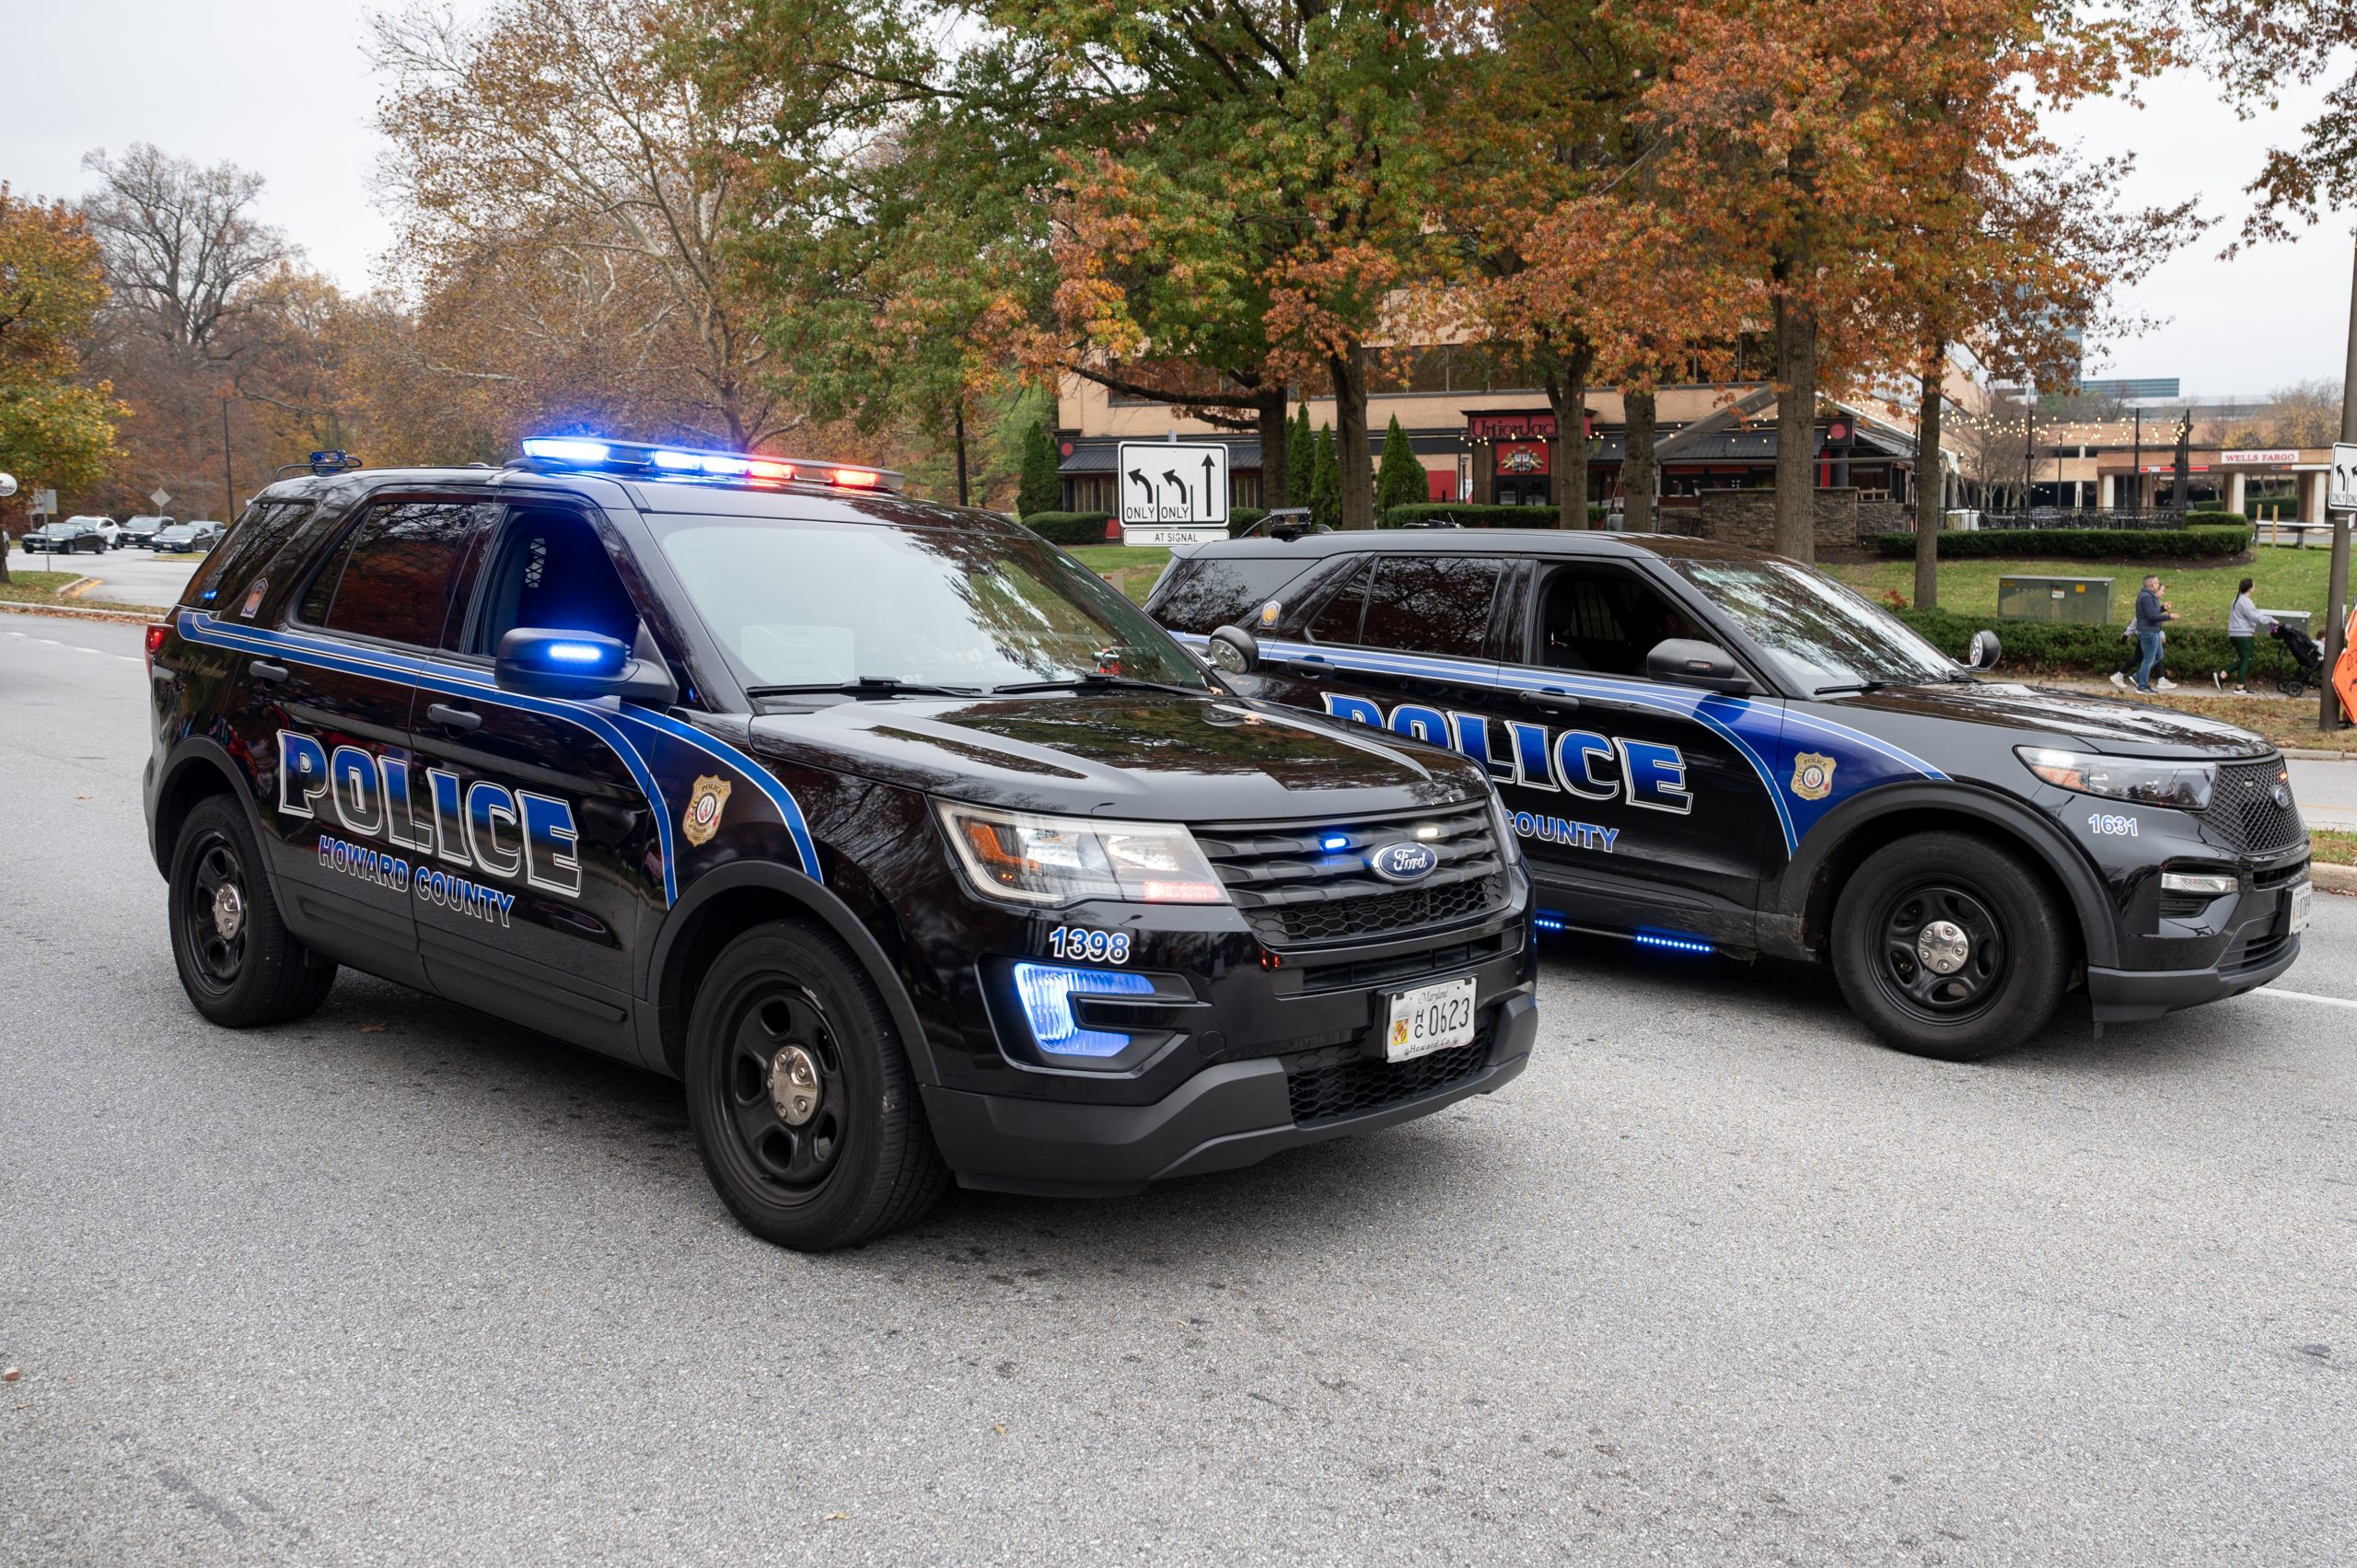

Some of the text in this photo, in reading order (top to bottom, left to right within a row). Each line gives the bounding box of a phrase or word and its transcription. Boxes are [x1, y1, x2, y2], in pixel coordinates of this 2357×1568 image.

[2225, 453, 2295, 462] WELLS FARGO
[2332, 493, 2345, 504] ONLY
[2348, 494, 2357, 505] ONL
[1126, 506, 1155, 519] ONLY
[1161, 506, 1190, 519] ONLY
[1155, 532, 1199, 542] AT SIGNAL
[276, 728, 583, 899] POLICE
[2088, 813, 2139, 837] 1631
[1393, 848, 1427, 872] Ford
[318, 834, 516, 928] HOWARD COUNTY
[1049, 925, 1131, 965] 1398
[1419, 985, 1449, 1005] Maryland
[1428, 997, 1470, 1037] 0623
[1410, 1040, 1439, 1053] Howard
